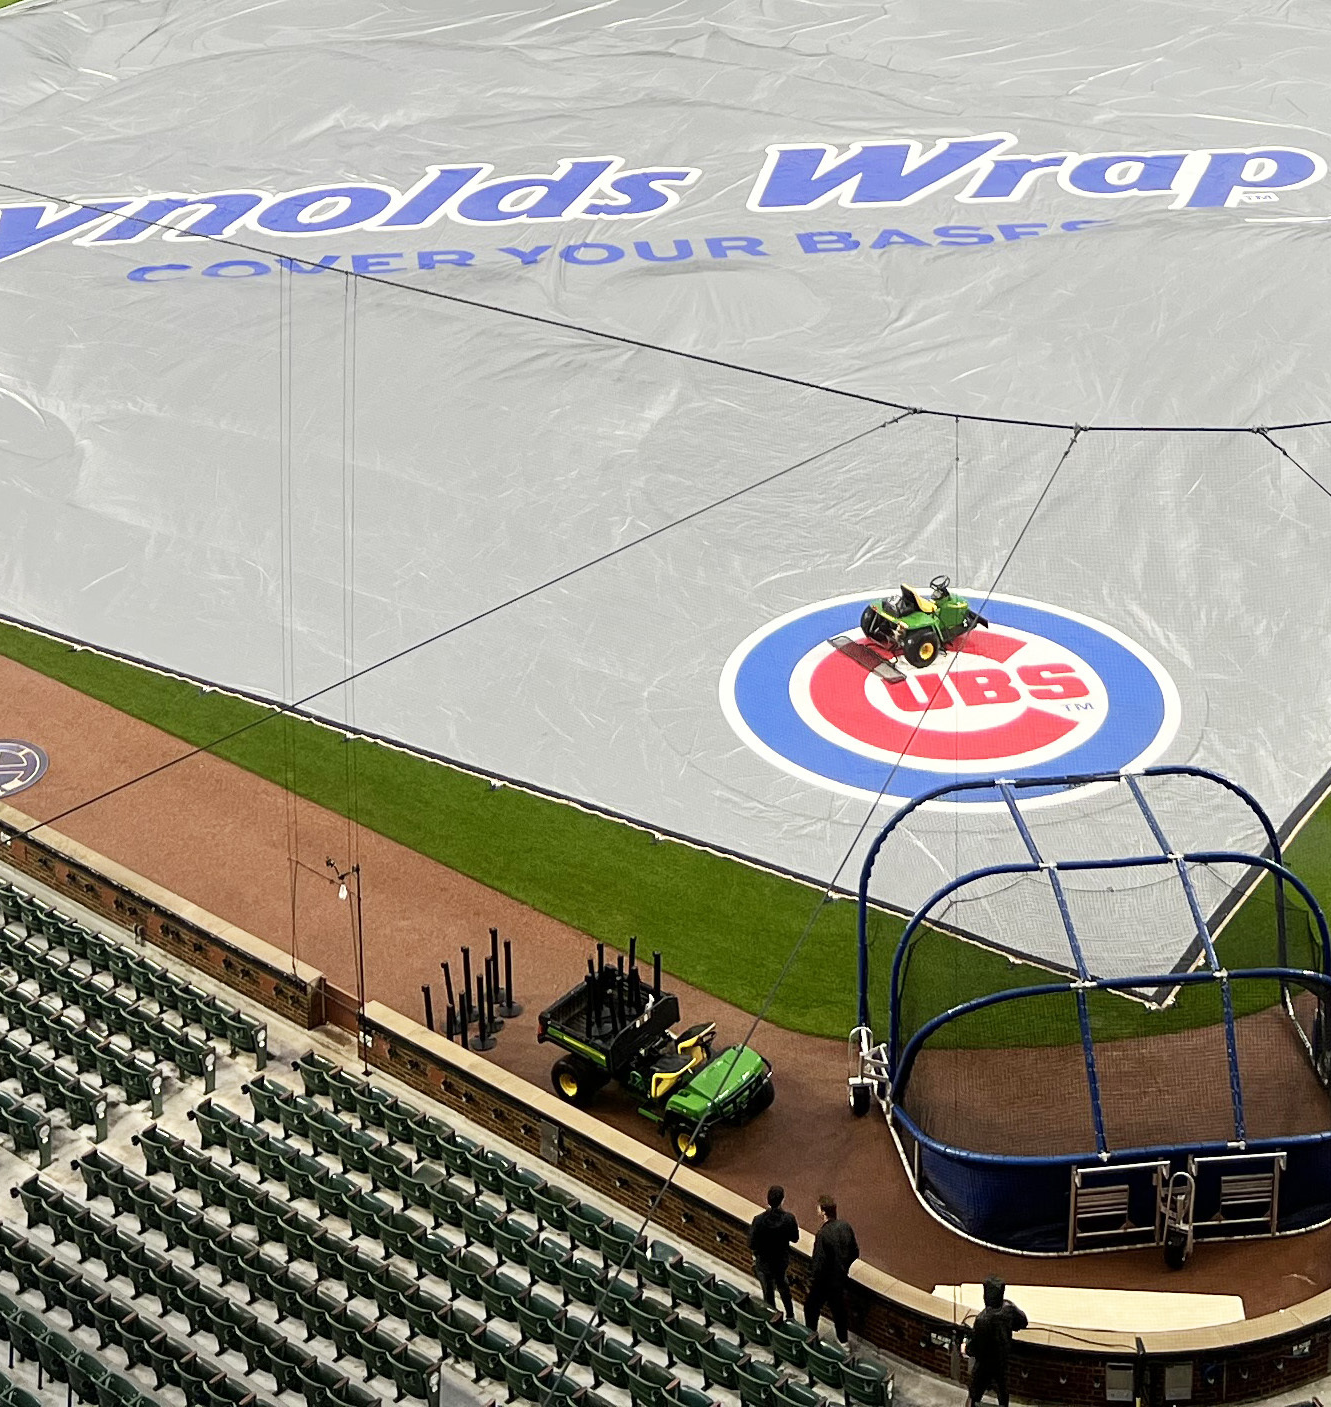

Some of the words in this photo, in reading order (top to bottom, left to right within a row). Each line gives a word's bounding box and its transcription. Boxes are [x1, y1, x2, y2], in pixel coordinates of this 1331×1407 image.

[746, 131, 1328, 213] Wrap
[125, 246, 480, 284] COVER
[498, 233, 774, 267] YOUR
